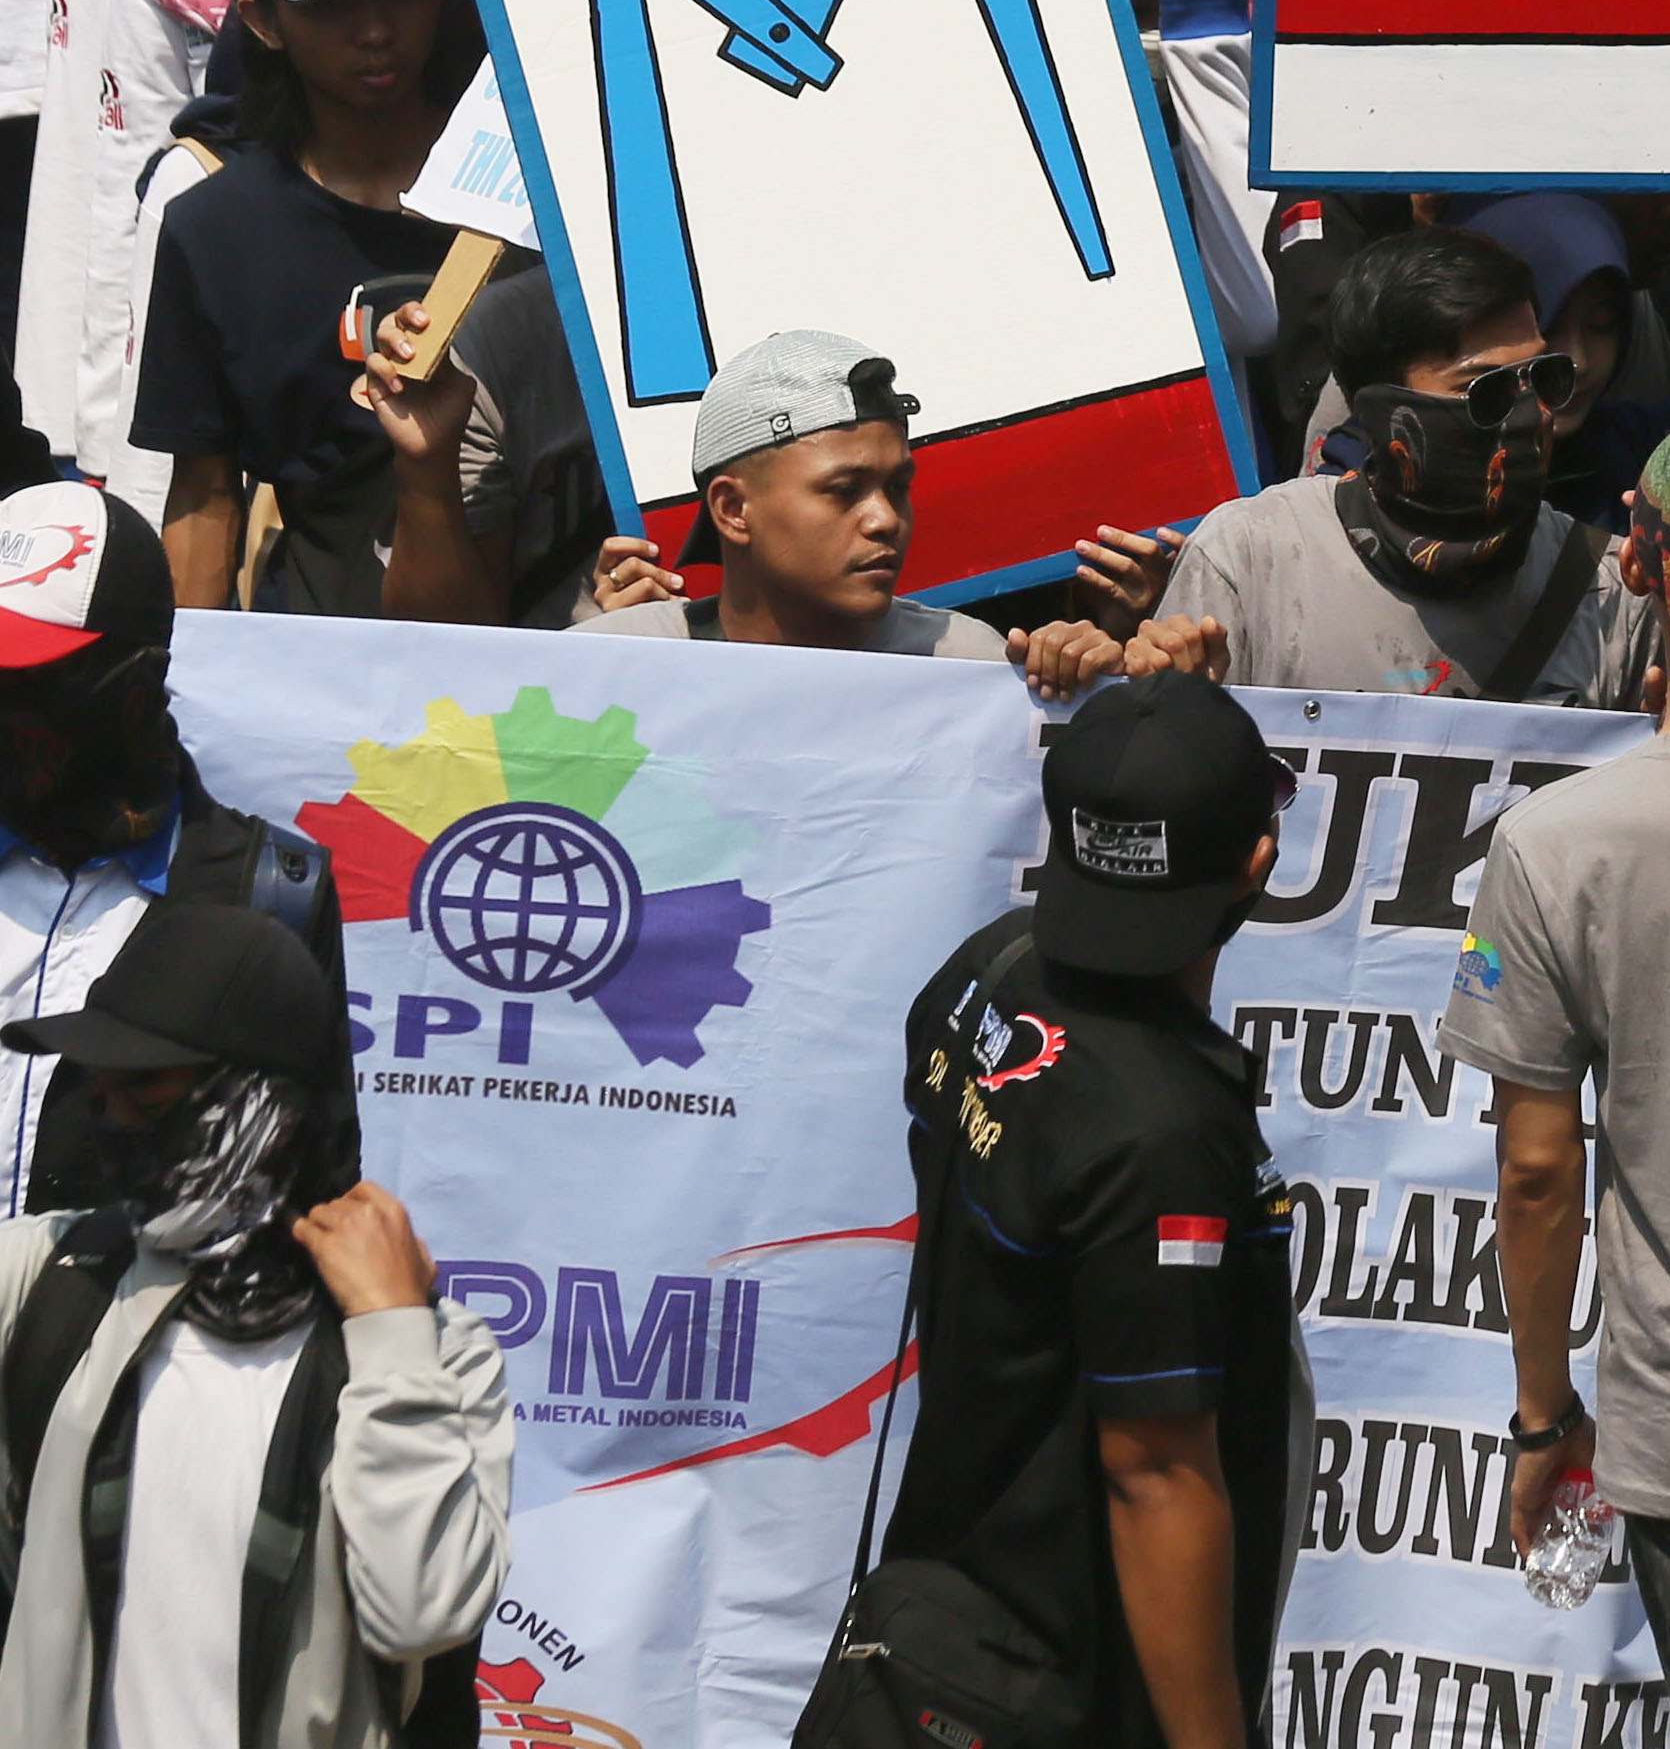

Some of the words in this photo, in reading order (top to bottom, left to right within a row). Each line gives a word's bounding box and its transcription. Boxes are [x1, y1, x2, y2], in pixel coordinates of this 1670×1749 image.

[346, 993, 534, 1066] SPI
[373, 1071, 475, 1098] SERIKAT
[483, 1077, 590, 1107] PEKERJA
[599, 1084, 737, 1119] INDONESIA
[1289, 1182, 1510, 1337] OLAK
[532, 1405, 612, 1428] METAL
[617, 1407, 748, 1431] INDONESIA
